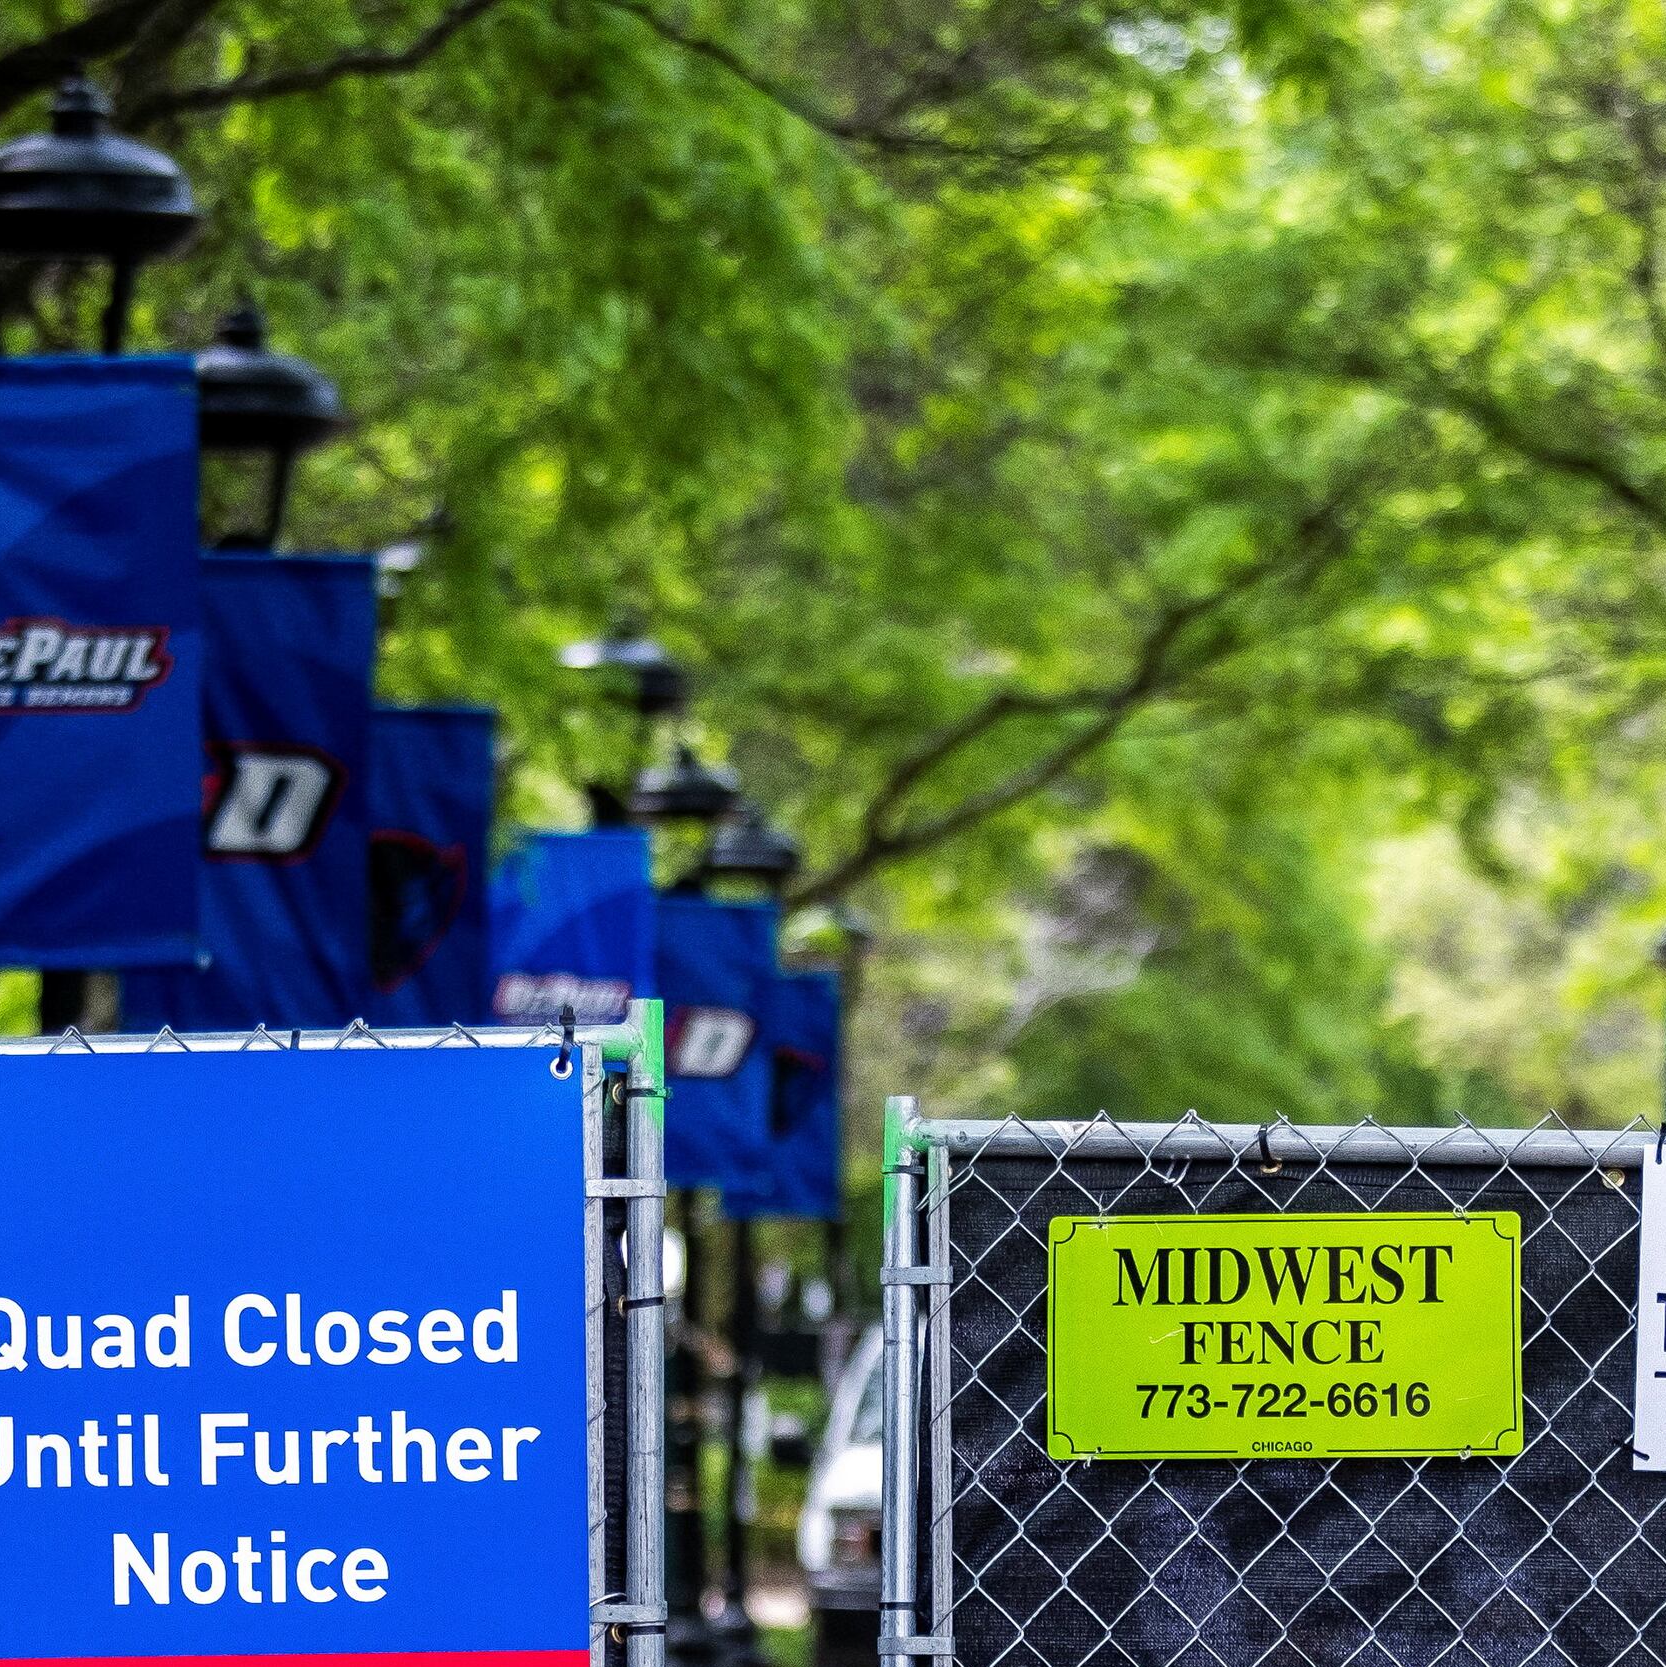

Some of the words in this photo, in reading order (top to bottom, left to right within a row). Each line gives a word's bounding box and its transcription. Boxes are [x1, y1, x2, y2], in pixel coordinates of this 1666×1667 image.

[209, 752, 331, 853] D
[1112, 1244, 1454, 1307] MIDWEST
[223, 1289, 520, 1368] Closed
[1178, 1319, 1385, 1367] FENCE
[1135, 1380, 1432, 1420] 773-722-6616
[199, 1409, 542, 1488] Further
[1251, 1440, 1314, 1454] CHICAGO
[112, 1530, 390, 1607] Notice
